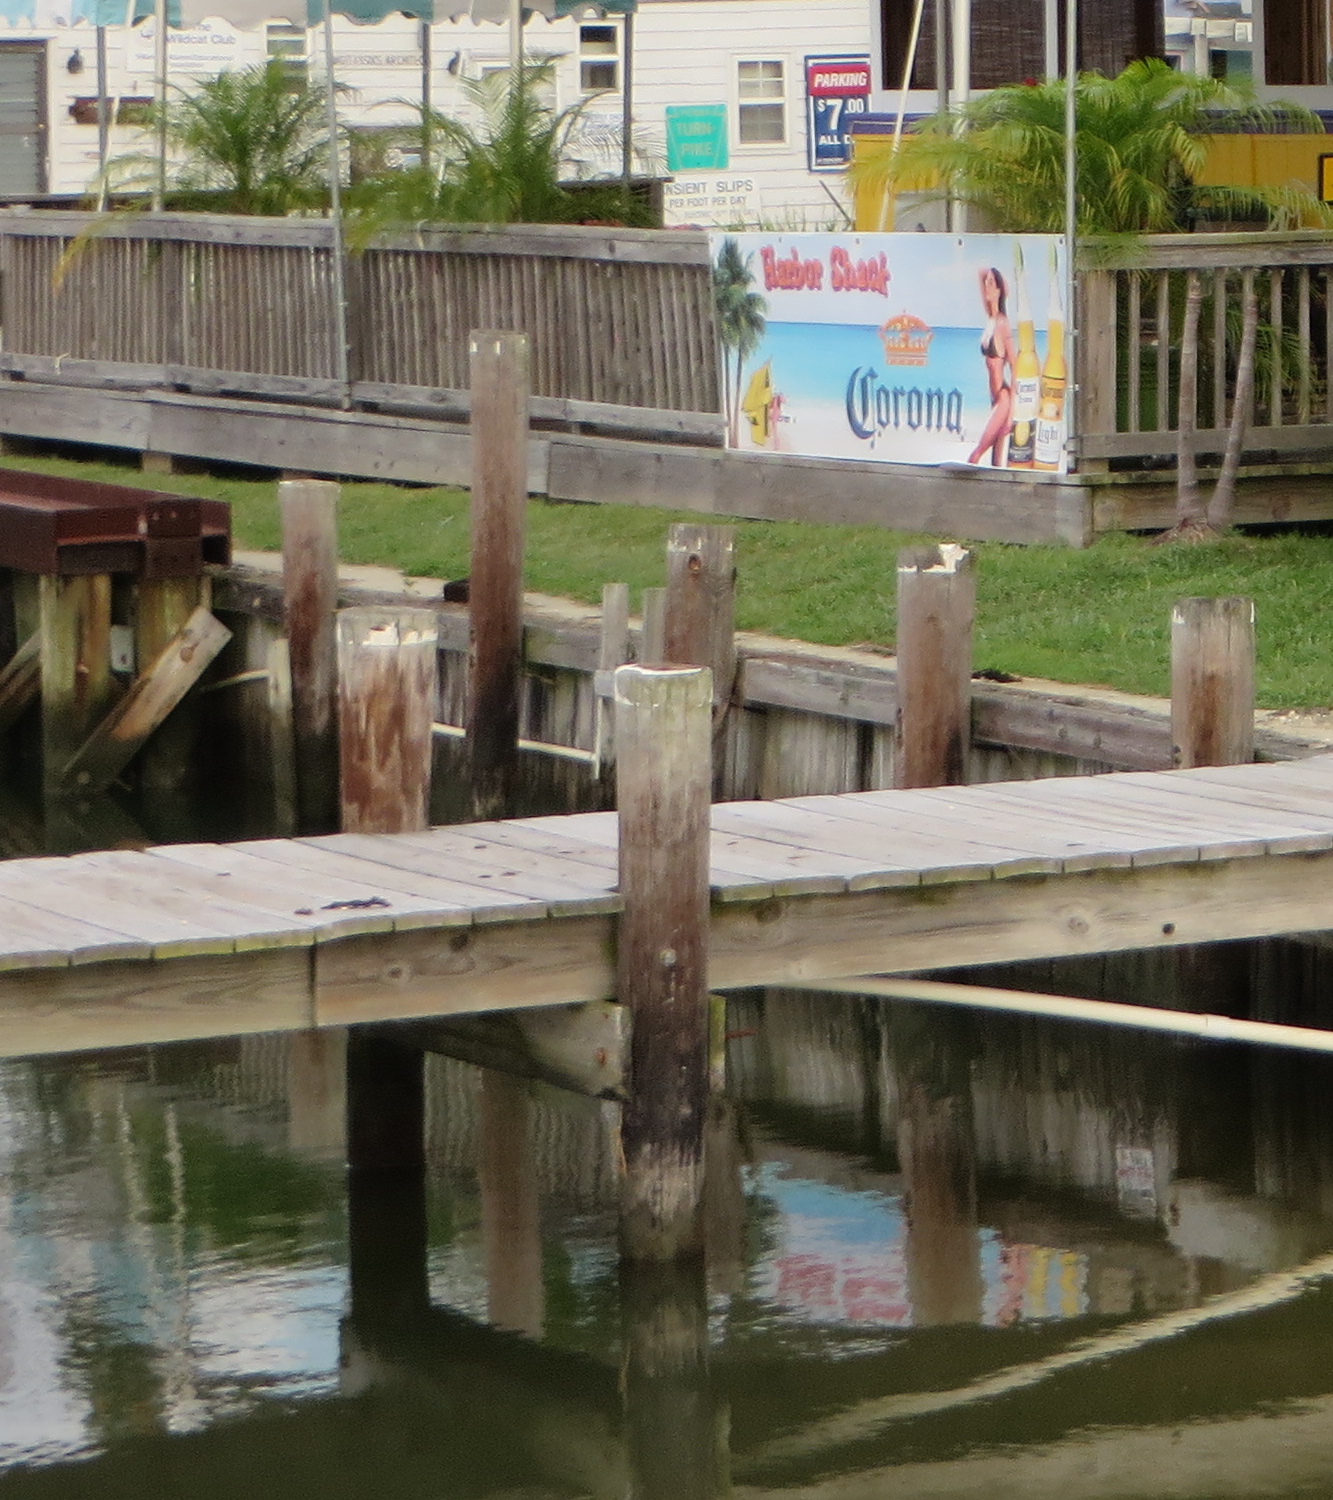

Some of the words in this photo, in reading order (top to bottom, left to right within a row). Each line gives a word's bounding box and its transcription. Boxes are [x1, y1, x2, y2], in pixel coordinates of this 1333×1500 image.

[211, 34, 236, 45] Club
[814, 71, 867, 88] PARKING
[819, 134, 841, 145] ALL
[716, 179, 753, 192] SLIPS
[670, 198, 685, 208] PER
[687, 197, 709, 207] FOOT
[712, 196, 727, 206] PER
[847, 365, 964, 448] Corona
